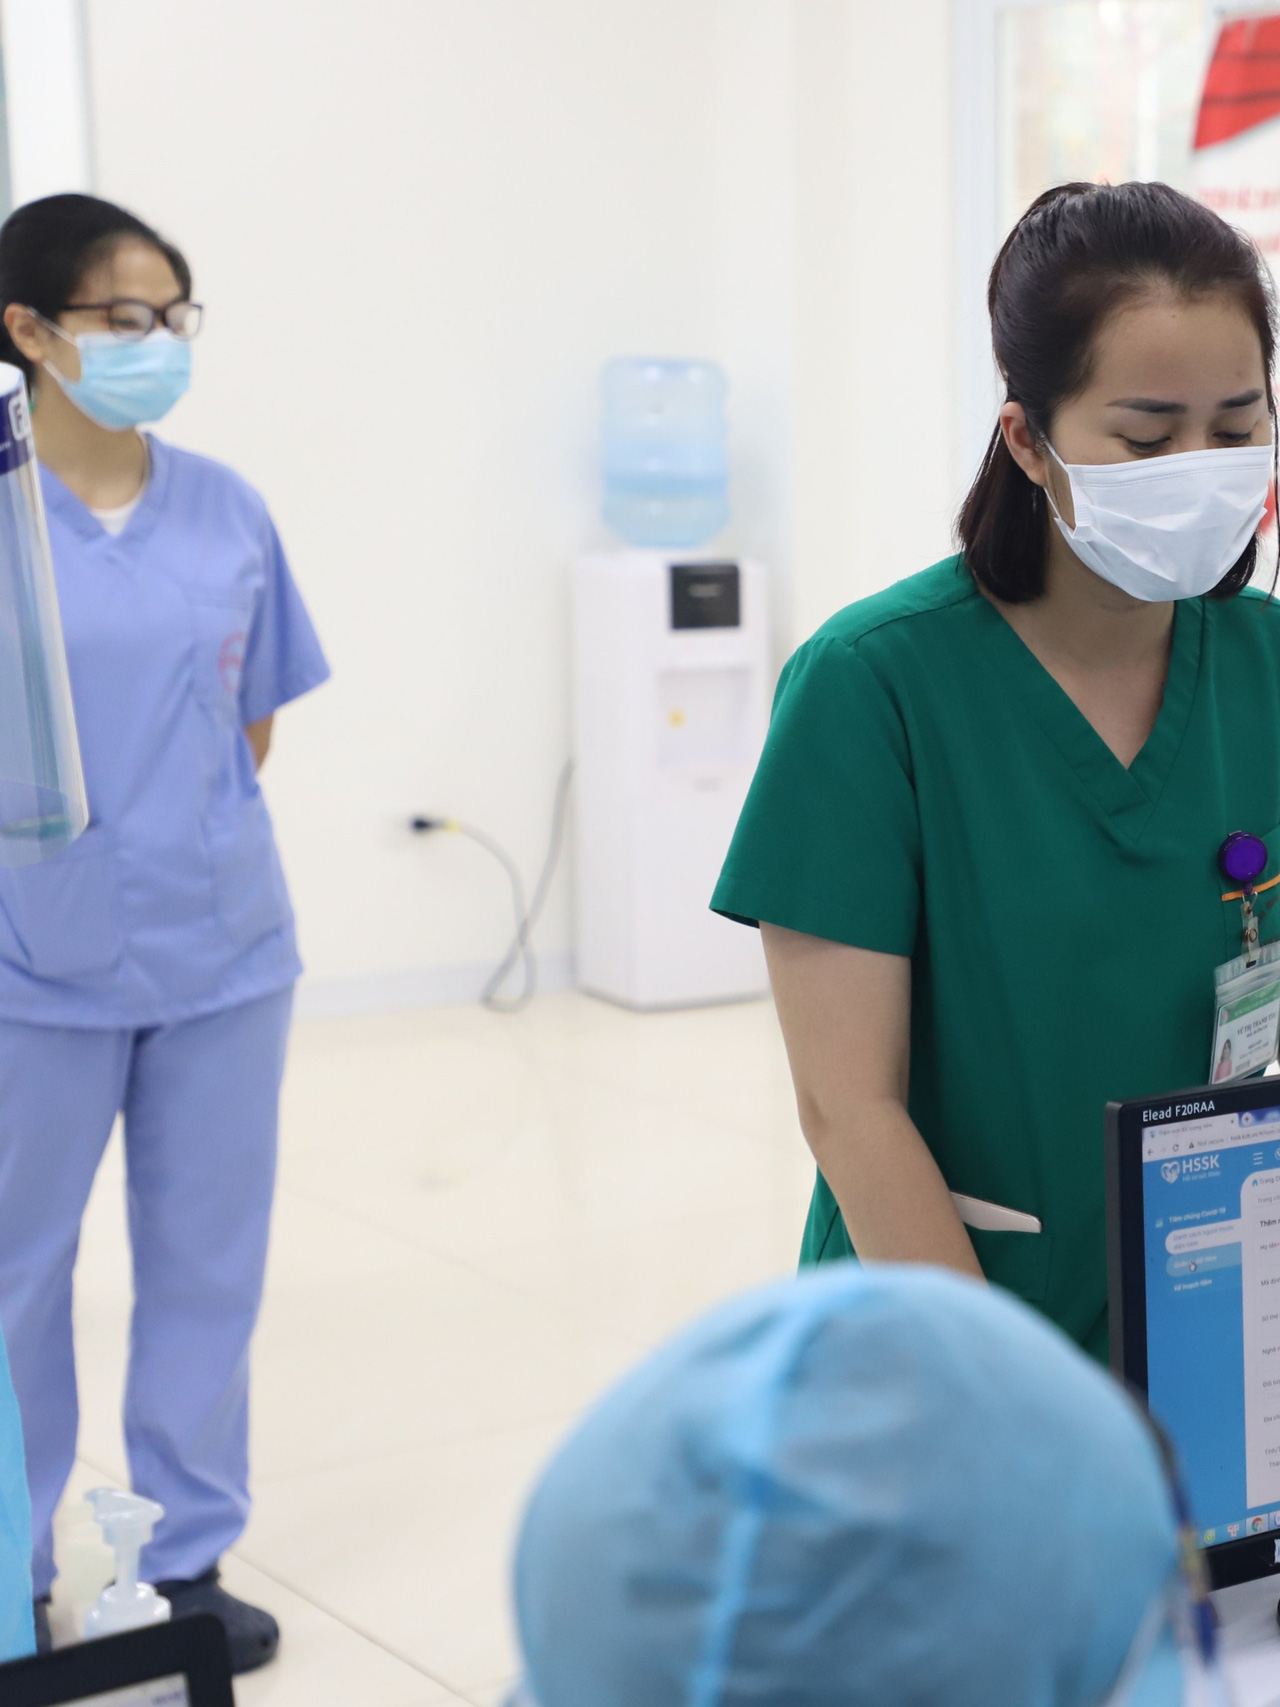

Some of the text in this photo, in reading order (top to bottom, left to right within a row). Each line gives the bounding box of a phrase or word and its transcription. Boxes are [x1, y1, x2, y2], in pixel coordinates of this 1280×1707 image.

[1142, 1100, 1215, 1122] Elead F20RAA
[1182, 1154, 1219, 1173] HSSK
